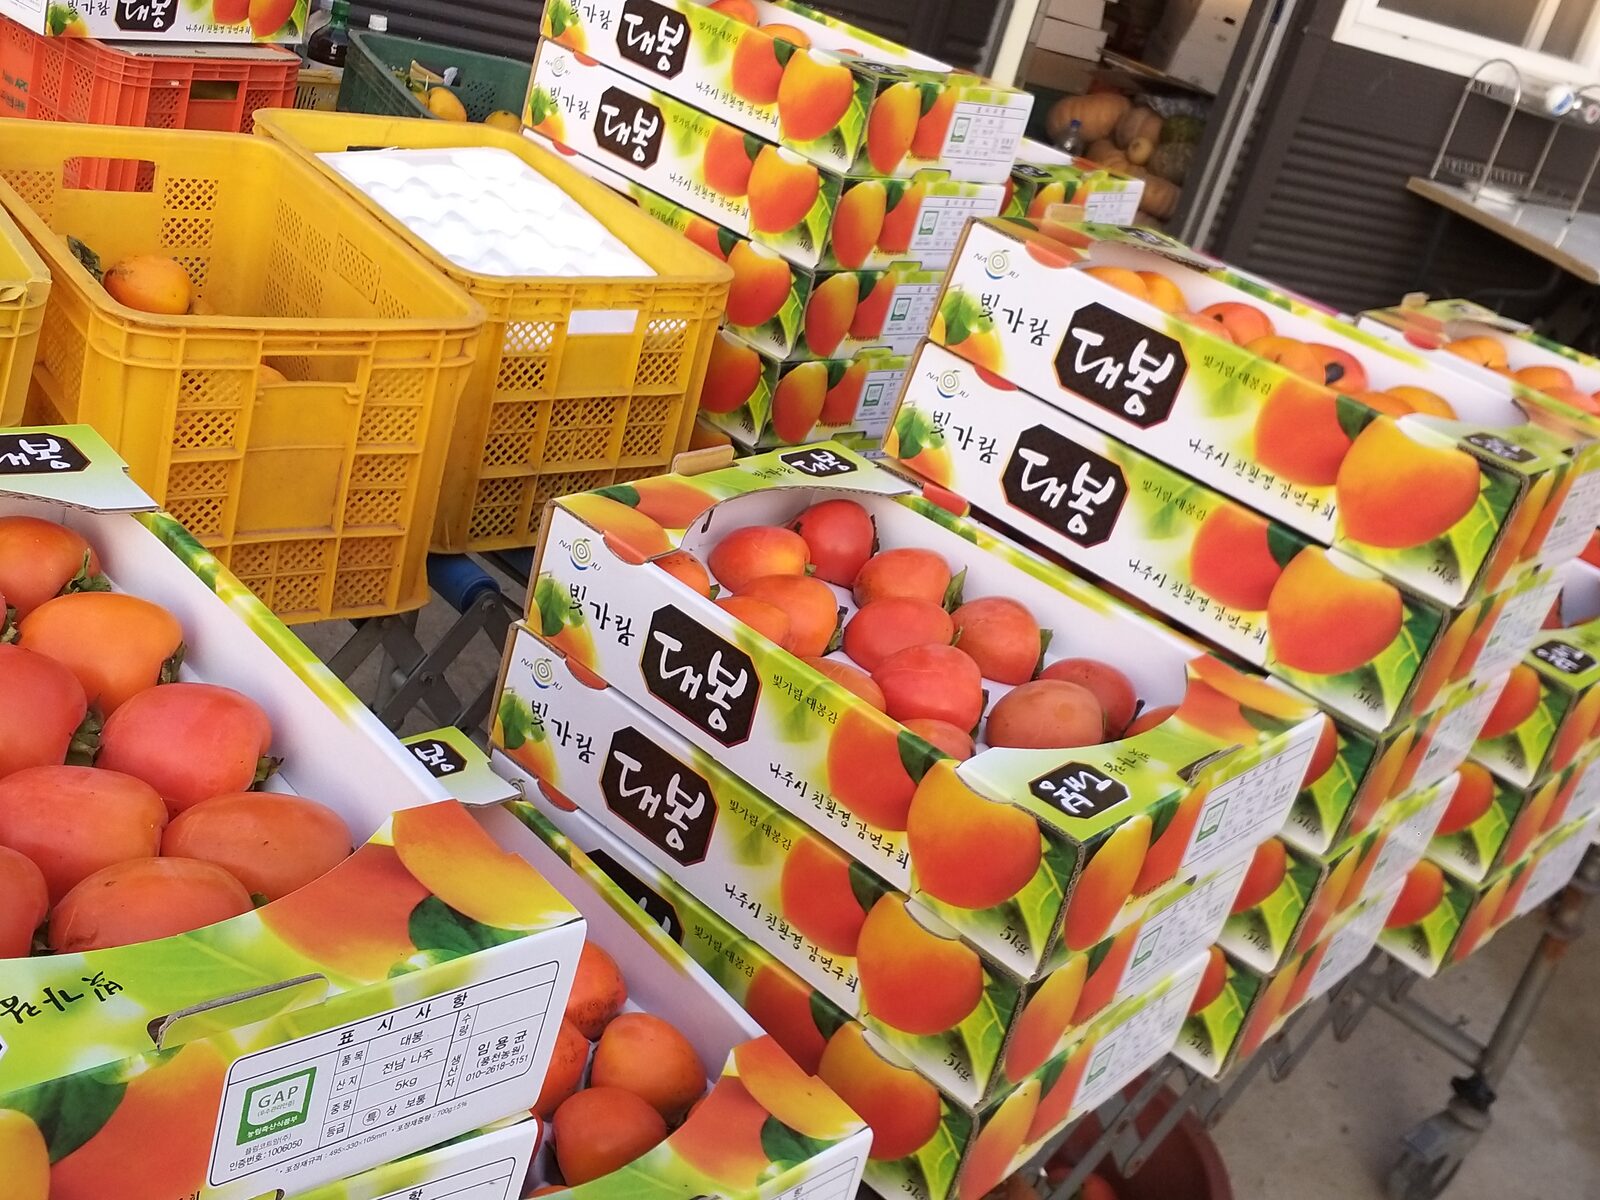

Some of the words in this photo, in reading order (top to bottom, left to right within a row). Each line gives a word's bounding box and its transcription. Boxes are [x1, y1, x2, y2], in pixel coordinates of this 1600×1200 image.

[569, 0, 613, 30] 빛가람
[623, 13, 685, 72] 대봉
[695, 82, 719, 100] 나주시
[550, 87, 590, 120] 빛가람
[600, 105, 659, 163] 대봉
[669, 173, 691, 191] 나주시
[974, 253, 988, 265] NA
[980, 292, 1051, 347] 빛가람
[1072, 327, 1175, 417] 대봉
[926, 371, 939, 382] NA
[791, 451, 850, 472] 대봉
[932, 410, 999, 465] 빛가람
[1019, 447, 1116, 536] 대봉
[1189, 438, 1230, 468] 나주시
[1234, 459, 1275, 490] 친환경
[1279, 482, 1336, 521] 감연구회
[558, 539, 572, 552] NA
[590, 562, 602, 571] JU
[1427, 558, 1459, 586] 5kg
[1129, 559, 1167, 588] 나주시
[1171, 581, 1209, 613] 친환경
[1214, 605, 1267, 645] 감연구회
[521, 658, 534, 670] NA
[551, 681, 563, 691] JU
[569, 583, 635, 647] 빛가람
[654, 629, 748, 732] 대봉
[772, 674, 804, 702] 빛가람
[806, 696, 839, 725] 대봉감
[531, 700, 596, 764] 빛가람
[613, 749, 705, 852] 대봉
[1039, 771, 1113, 814] 대봉
[729, 800, 759, 827] 빛가람
[761, 823, 793, 851] 대봉감
[769, 762, 808, 797] 나주시
[812, 791, 852, 828] 친환경
[855, 821, 910, 870] 감연구회
[693, 924, 723, 953] 빛가람
[725, 949, 755, 978] 대봉감
[724, 883, 761, 919] 나주시
[765, 912, 804, 950] 친환경
[807, 945, 859, 993] 감연구회
[999, 926, 1031, 956] 5kg
[0, 971, 123, 1024] 빛가람
[400, 1030, 424, 1047] 대봉
[382, 1057, 406, 1075] 전남
[410, 1048, 434, 1066] 나주
[465, 1054, 528, 1082] 010-2618-5151
[943, 1052, 972, 1083] 5kg
[258, 1086, 298, 1108] GAP
[326, 1122, 346, 1138] 등급
[386, 1104, 398, 1117] 상
[405, 1094, 427, 1110] 보통
